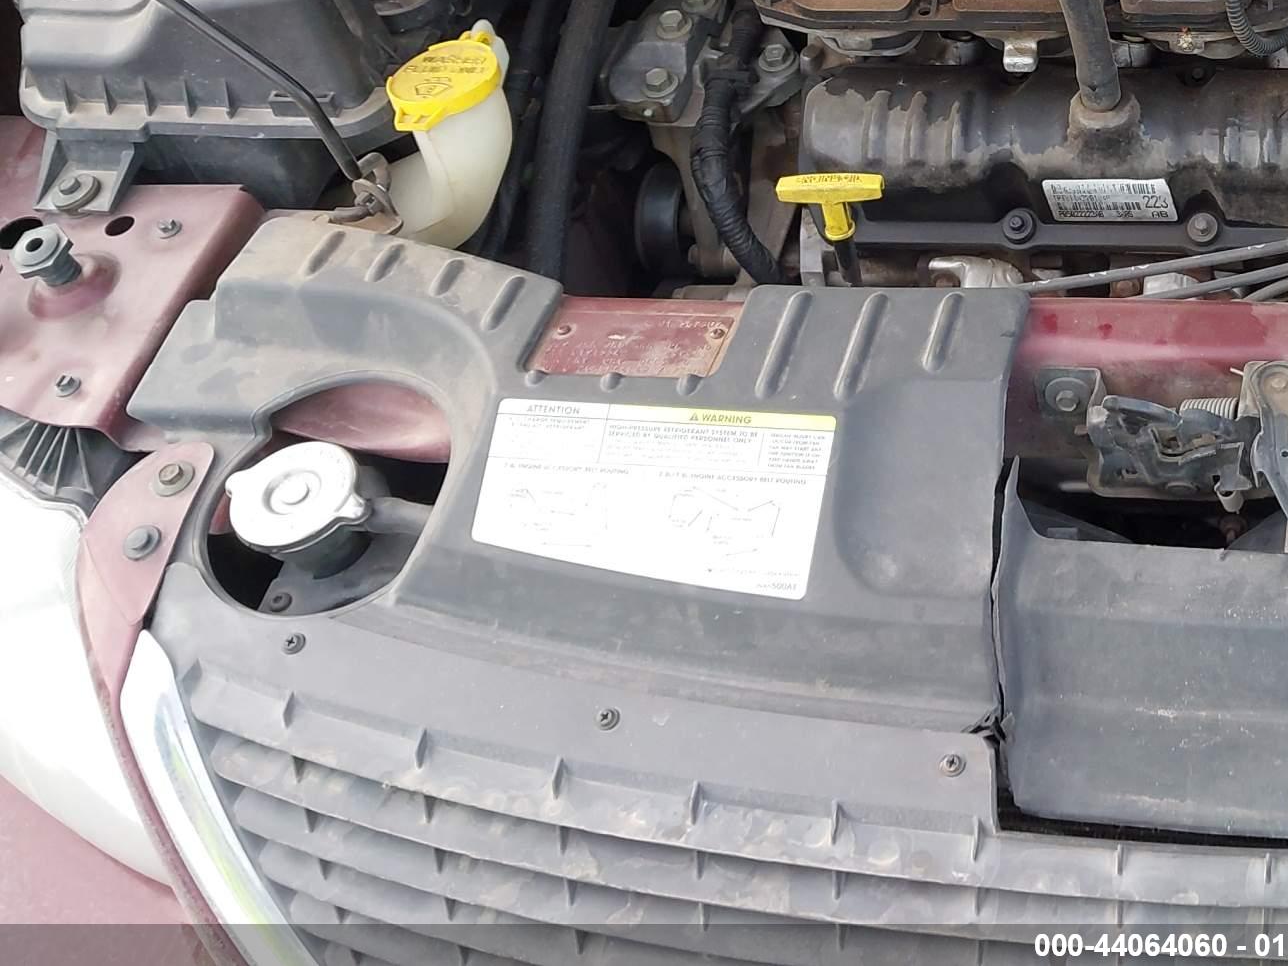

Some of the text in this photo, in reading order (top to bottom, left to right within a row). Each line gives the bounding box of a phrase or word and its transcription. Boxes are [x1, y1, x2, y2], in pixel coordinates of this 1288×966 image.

[1142, 195, 1169, 209] 223
[1152, 210, 1168, 218] AB
[526, 404, 580, 415] ATTENTION
[702, 412, 752, 424] WARNING
